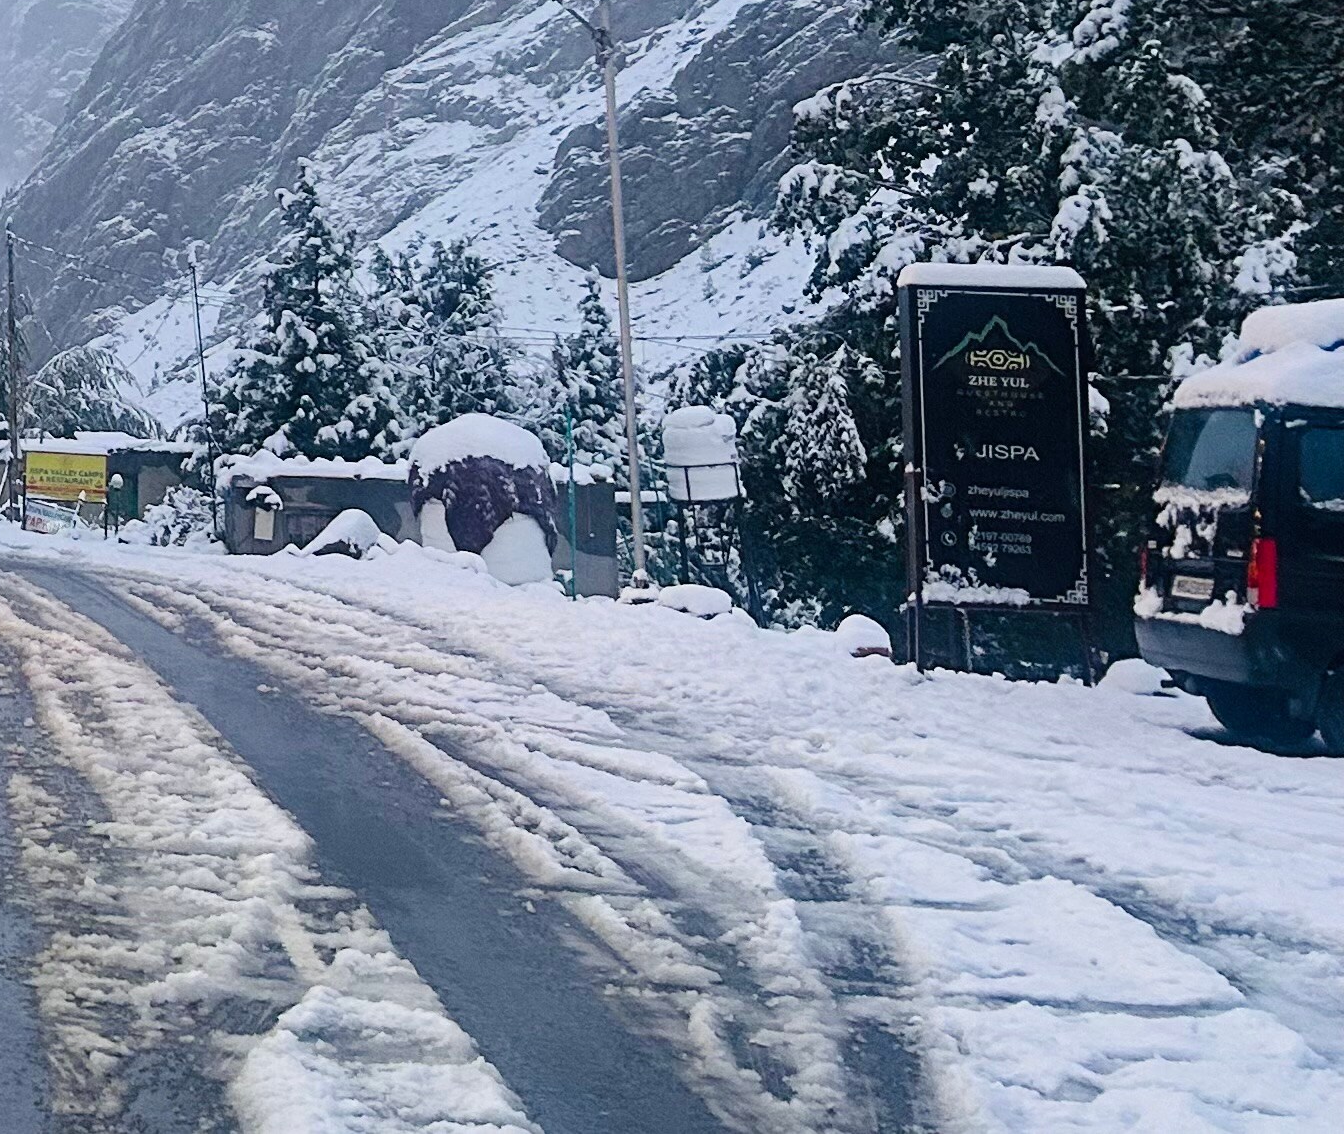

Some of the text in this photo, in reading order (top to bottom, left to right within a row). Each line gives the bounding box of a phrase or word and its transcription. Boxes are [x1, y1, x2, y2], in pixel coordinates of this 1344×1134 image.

[968, 374, 1030, 388] ZHE YUL
[976, 444, 1040, 461] JISPA
[968, 509, 1066, 523] www.zheyul.com
